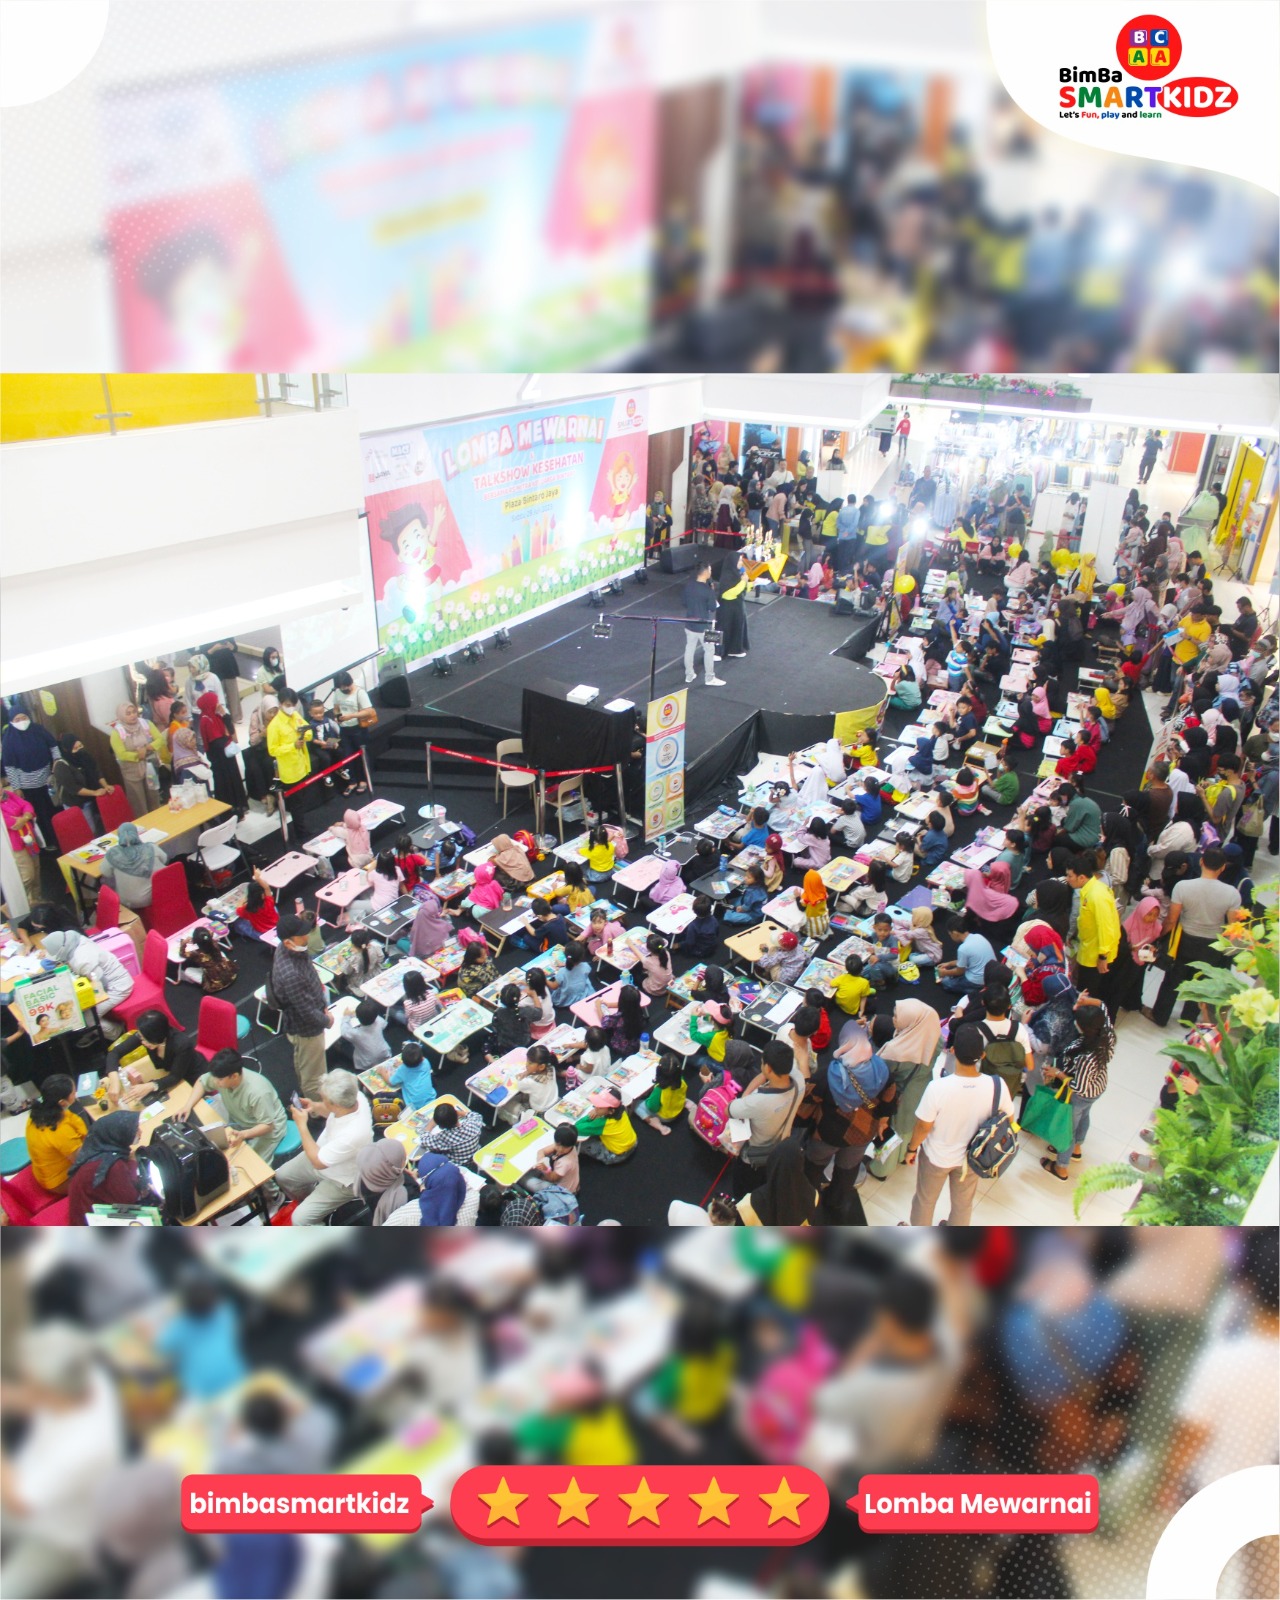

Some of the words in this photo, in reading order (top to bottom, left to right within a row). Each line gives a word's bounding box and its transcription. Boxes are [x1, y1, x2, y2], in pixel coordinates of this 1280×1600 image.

[442, 425, 515, 482] LOMBA
[517, 415, 606, 451] MEWARNAI
[474, 466, 530, 490] TALKSHOW
[532, 452, 584, 476] KESEHATAN
[504, 499, 522, 510] Plaza
[523, 491, 545, 505] Bintaro
[545, 488, 559, 500] Jaya
[24, 985, 59, 1000] FACIAL
[26, 992, 56, 1007] BASIC
[29, 1002, 54, 1016] 99K
